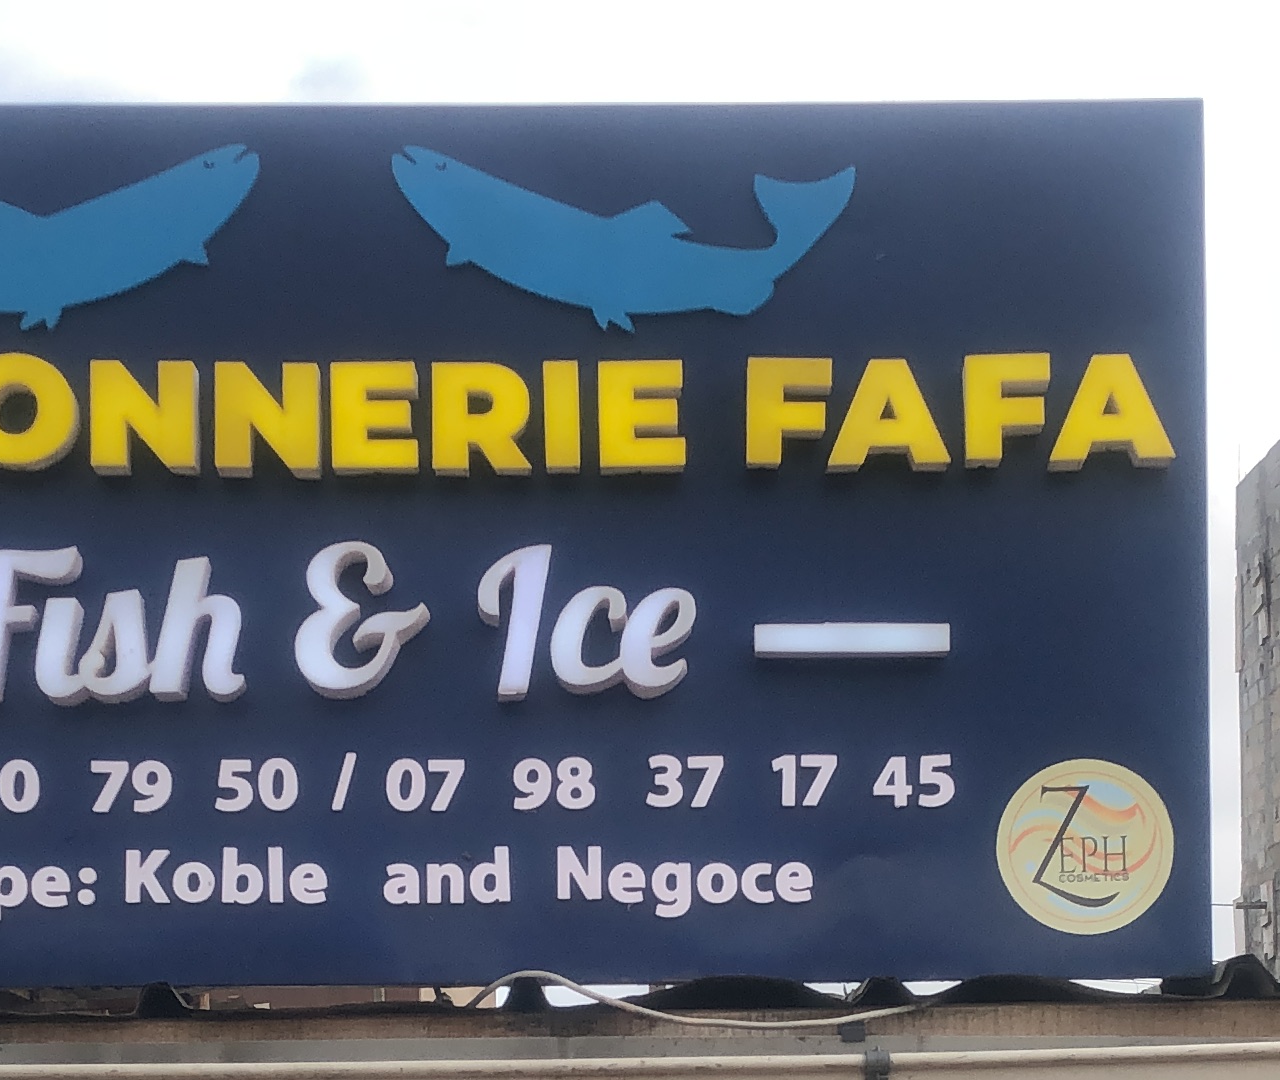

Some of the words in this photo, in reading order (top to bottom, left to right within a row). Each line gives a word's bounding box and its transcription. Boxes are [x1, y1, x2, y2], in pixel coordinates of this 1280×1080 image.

[745, 352, 1177, 474] FAFA
[294, 540, 431, 700] &
[477, 543, 697, 704] Ice
[90, 757, 174, 813] 79
[213, 757, 300, 813] 50
[332, 751, 357, 813] /
[384, 757, 467, 813] 07
[512, 755, 597, 811] 98
[645, 754, 725, 810] 37
[771, 753, 839, 809] 17
[872, 753, 957, 809] 45
[123, 845, 328, 906] Koble
[382, 845, 512, 905] and
[556, 845, 815, 919] Negoce
[1032, 784, 1128, 908] ZEPH
[1058, 873, 1130, 884] COSMETICS
